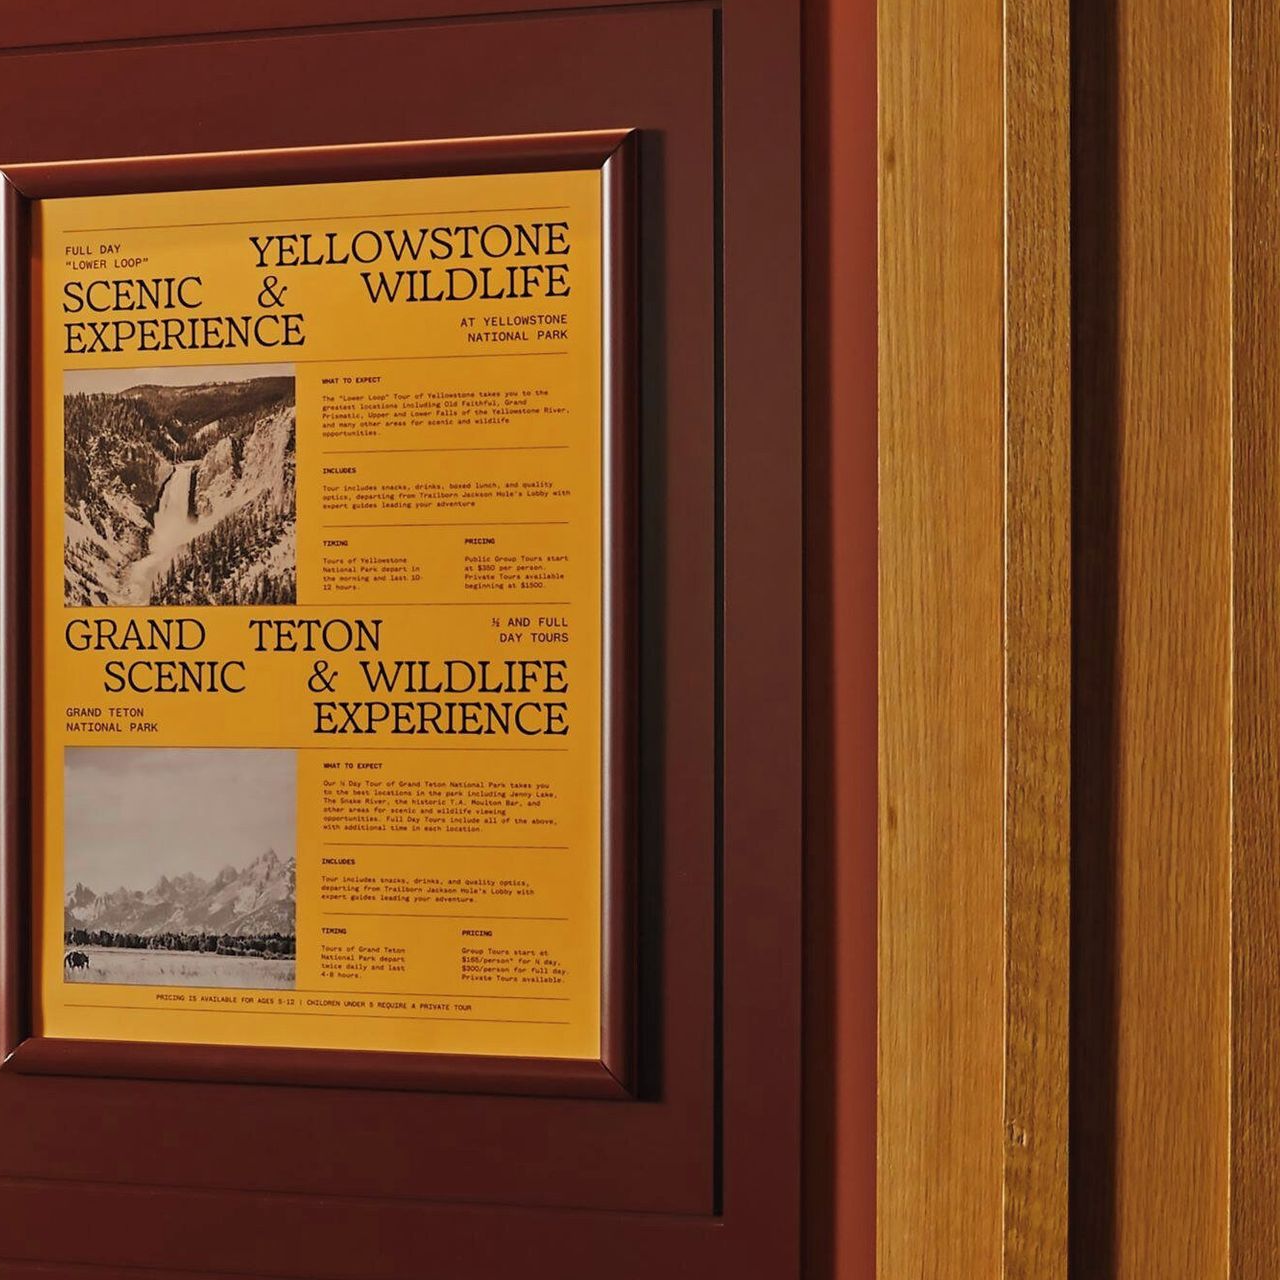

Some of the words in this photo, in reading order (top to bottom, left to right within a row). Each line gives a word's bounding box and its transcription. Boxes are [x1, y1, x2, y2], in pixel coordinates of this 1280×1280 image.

[65, 246, 93, 256] FULL
[99, 244, 121, 254] DAY
[249, 221, 570, 268] YELLOWSTONE
[63, 276, 203, 313] SCENIC
[257, 275, 288, 308] &
[360, 264, 571, 303] WILDLIFE
[64, 313, 306, 354] EXPERIENCE
[460, 317, 476, 327] AT
[483, 314, 567, 326] YELLOWSTONE
[468, 331, 529, 342] NATIONAL
[537, 330, 568, 340] PARK
[65, 618, 206, 651] GRAND
[249, 619, 383, 652] TETON
[499, 633, 523, 643] DAY
[530, 632, 569, 643] TOURS
[507, 617, 531, 627] AND
[538, 617, 568, 627] FULL
[104, 661, 246, 693] SCENIC
[308, 660, 338, 693] &
[359, 660, 568, 693] WILDLIFE
[66, 707, 102, 717] GRAND
[108, 708, 144, 718] TETON
[66, 722, 122, 732] NATIONAL
[129, 722, 158, 732] PARK
[313, 701, 569, 736] EXPERIENCE
[377, 1002, 407, 1010] REQUIRE
[419, 1003, 450, 1011] PRIVATE
